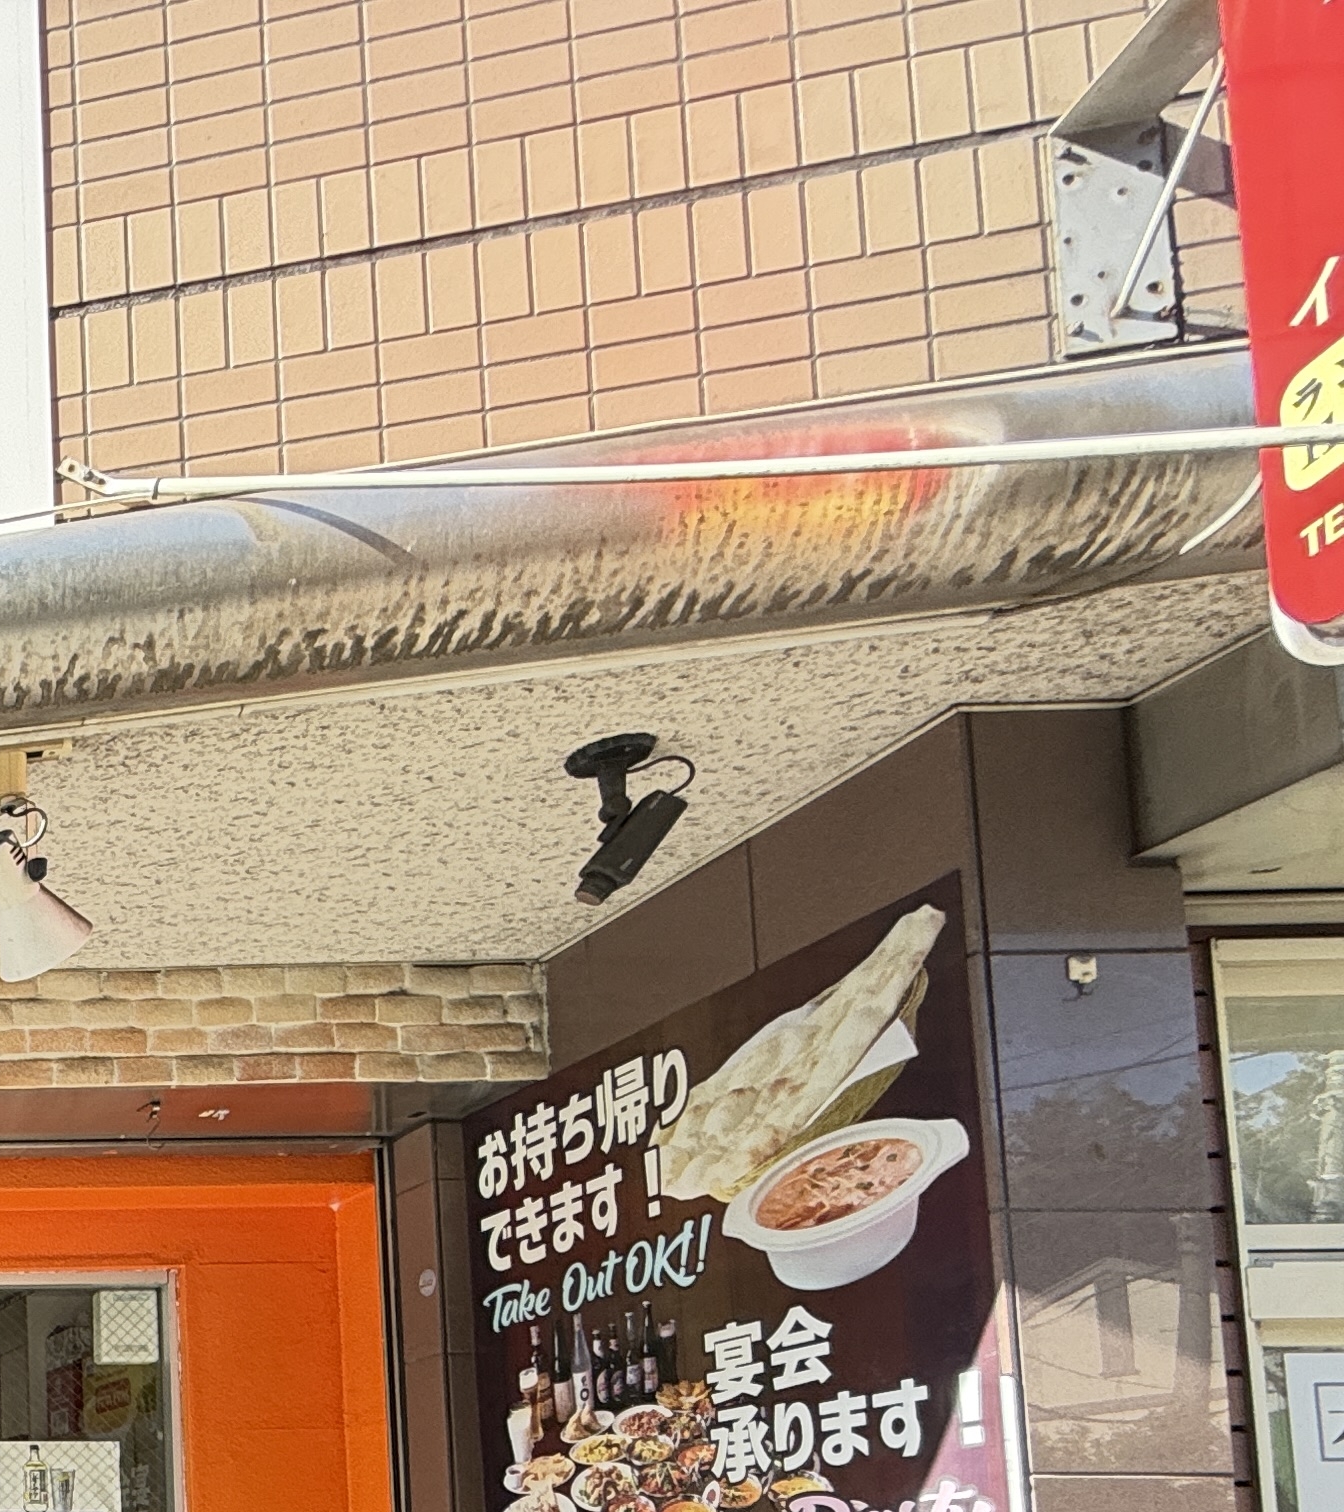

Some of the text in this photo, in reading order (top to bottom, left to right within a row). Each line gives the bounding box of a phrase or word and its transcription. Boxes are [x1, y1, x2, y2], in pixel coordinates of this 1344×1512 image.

[476, 1047, 689, 1199] お持ち帰り
[482, 1277, 551, 1335] Take
[563, 1255, 620, 1314] Out
[705, 1304, 834, 1404] 宴会
